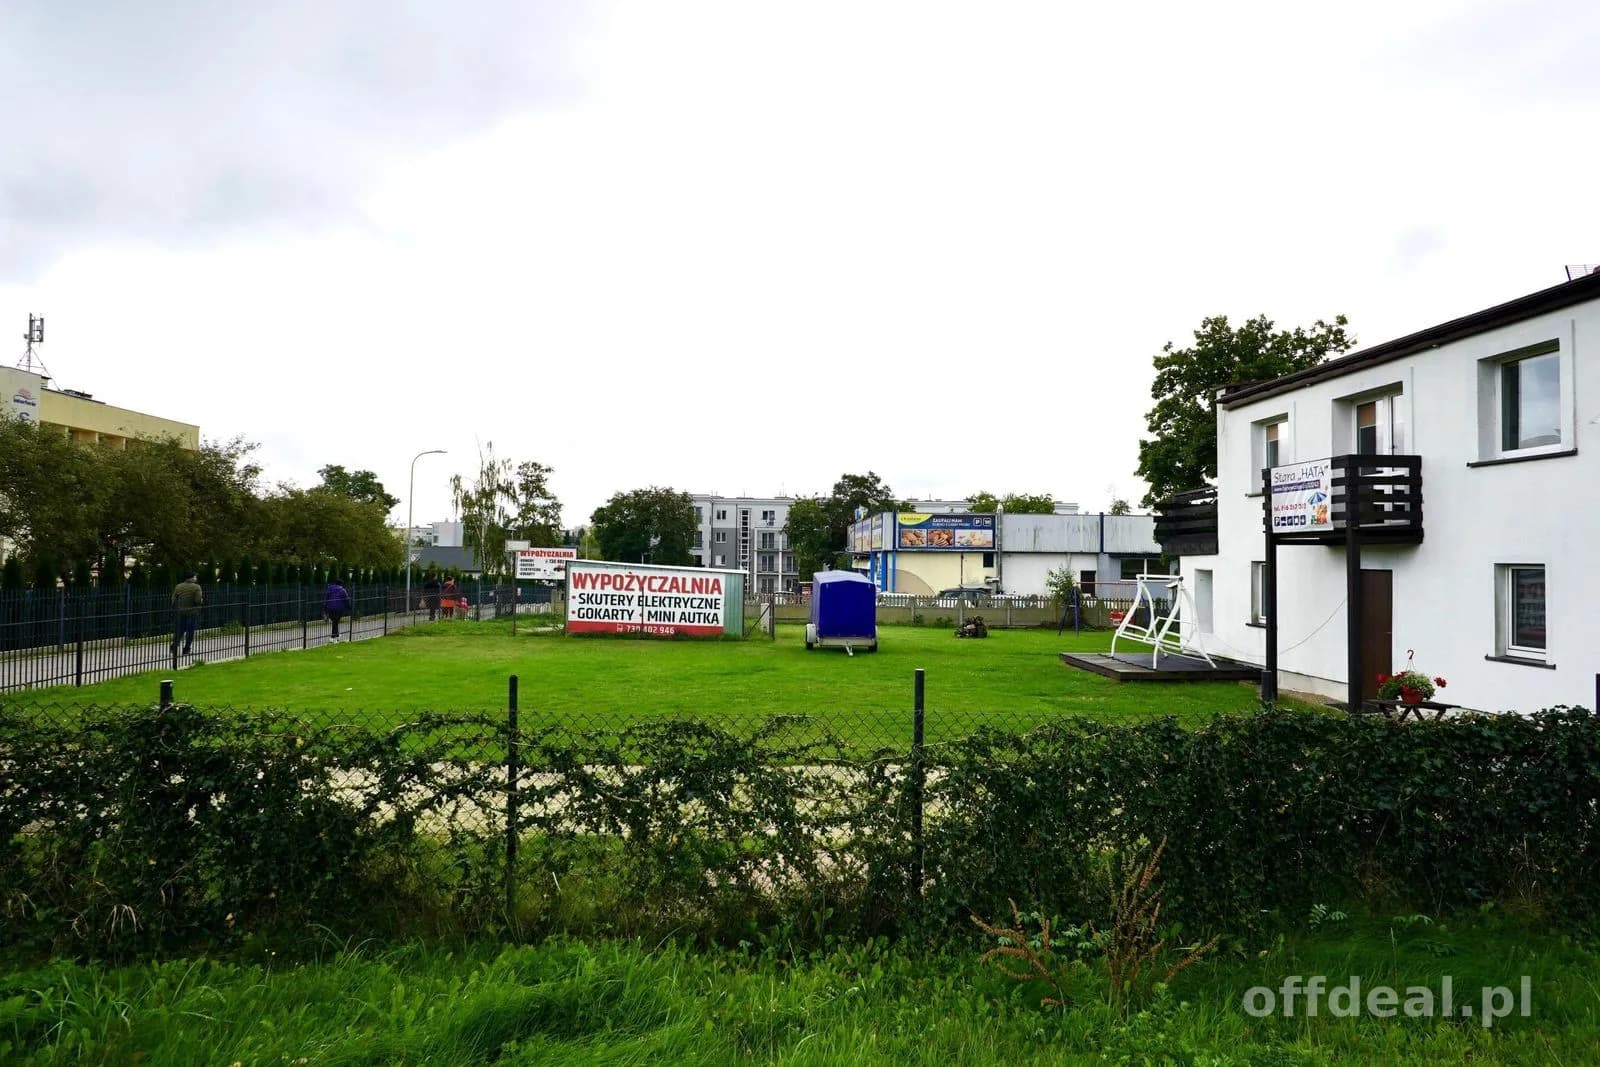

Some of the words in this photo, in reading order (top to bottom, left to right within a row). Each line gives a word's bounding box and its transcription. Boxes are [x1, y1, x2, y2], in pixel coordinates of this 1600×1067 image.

[1274, 471, 1296, 483] Stara
[520, 550, 574, 558] WYPOŻYCZALNIA
[572, 571, 722, 595] WYPOŻYCZALNIA
[578, 592, 635, 607] SKUTERY
[637, 594, 721, 610] ELEKTRYCZNE
[577, 607, 634, 621] GOKARTY
[647, 610, 676, 623] MINI
[679, 612, 720, 625] AUTKA
[660, 626, 675, 634] 946
